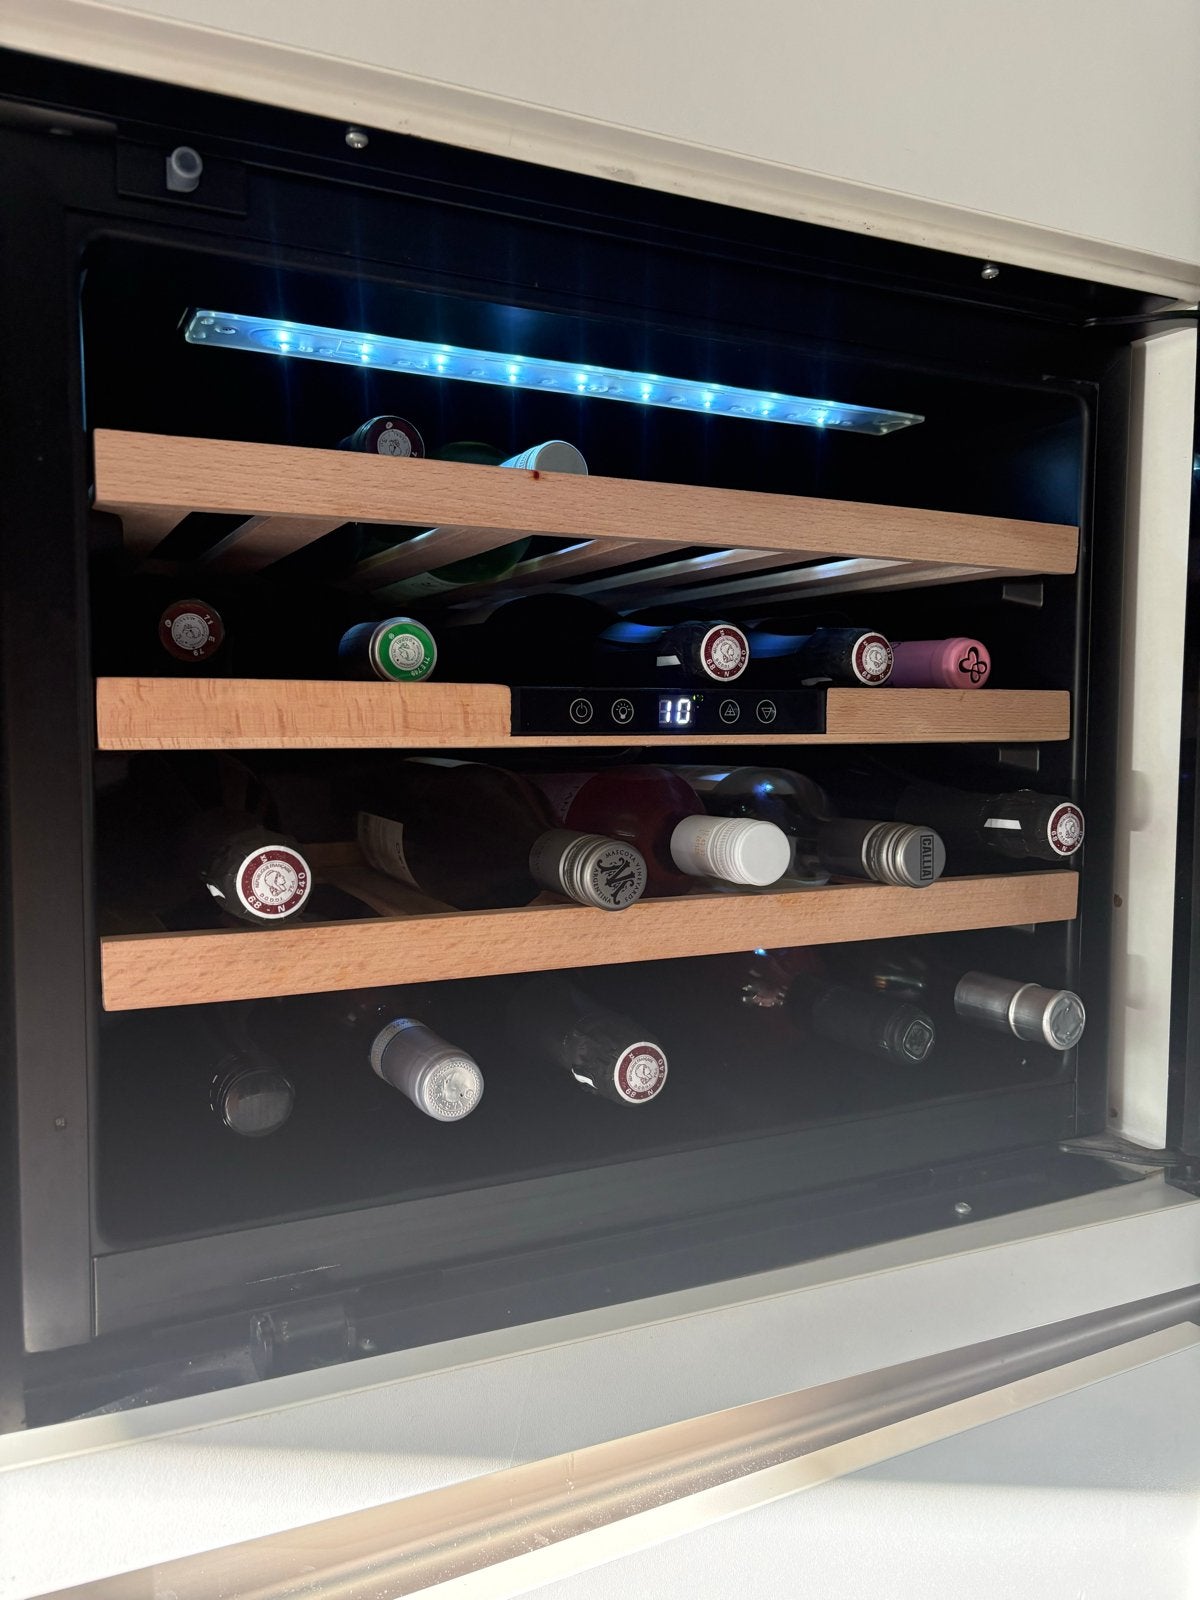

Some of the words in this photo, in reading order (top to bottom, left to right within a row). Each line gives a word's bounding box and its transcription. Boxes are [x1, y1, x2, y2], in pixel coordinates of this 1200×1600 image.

[665, 698, 692, 725] 10
[605, 849, 637, 863] MASCOTA
[624, 863, 643, 903] VINEYARDS
[922, 838, 932, 877] CALLIA
[247, 895, 262, 909] 68
[277, 904, 286, 913] N
[296, 872, 306, 896] 540
[592, 867, 612, 904] ARGENTINA
